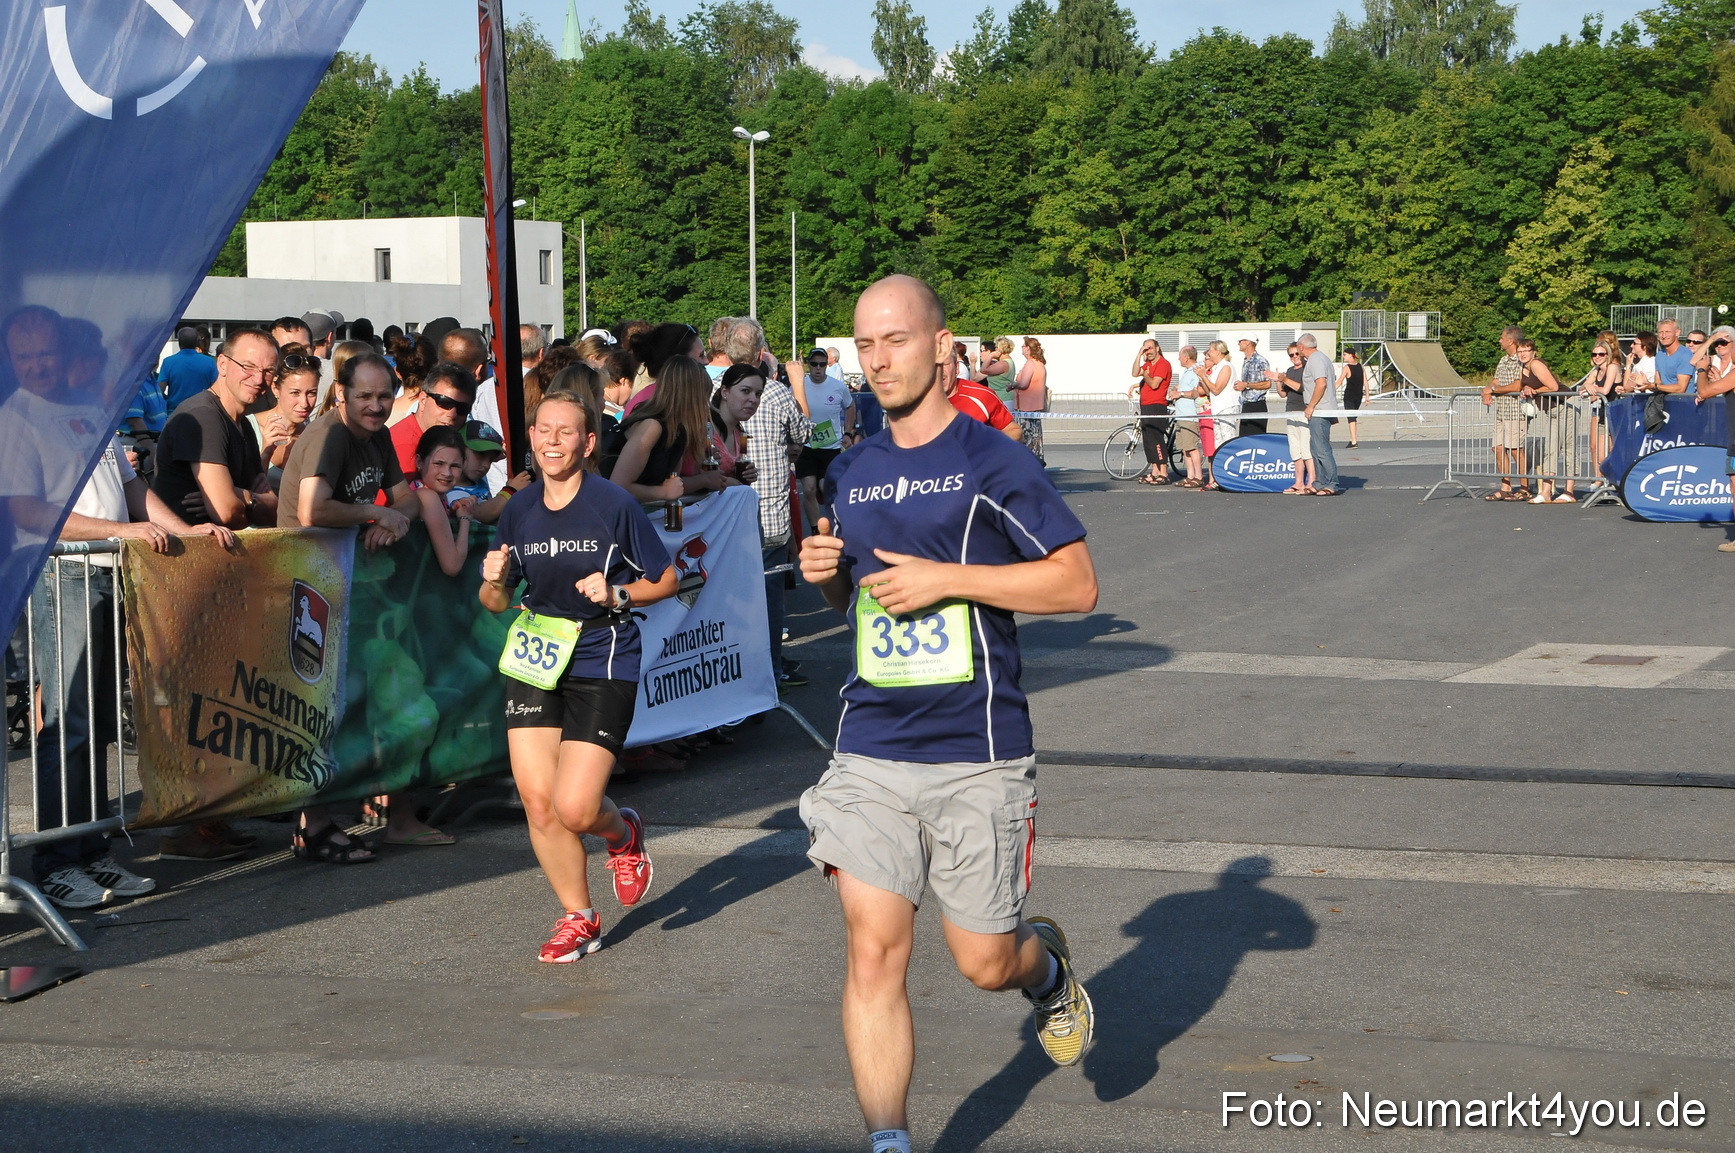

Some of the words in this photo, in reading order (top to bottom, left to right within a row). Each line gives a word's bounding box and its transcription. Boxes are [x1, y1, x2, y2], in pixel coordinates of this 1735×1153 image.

[811, 429, 831, 442] 431
[849, 484, 894, 505] EURO
[909, 473, 964, 496] POLES
[524, 542, 549, 556] EURO
[559, 539, 598, 553] POLES
[514, 630, 560, 671] 335
[656, 619, 725, 662] eumarkter
[871, 612, 950, 659] 333
[643, 646, 742, 709] Lammsbräu
[882, 660, 908, 668] Christian
[514, 703, 543, 717] Sport
